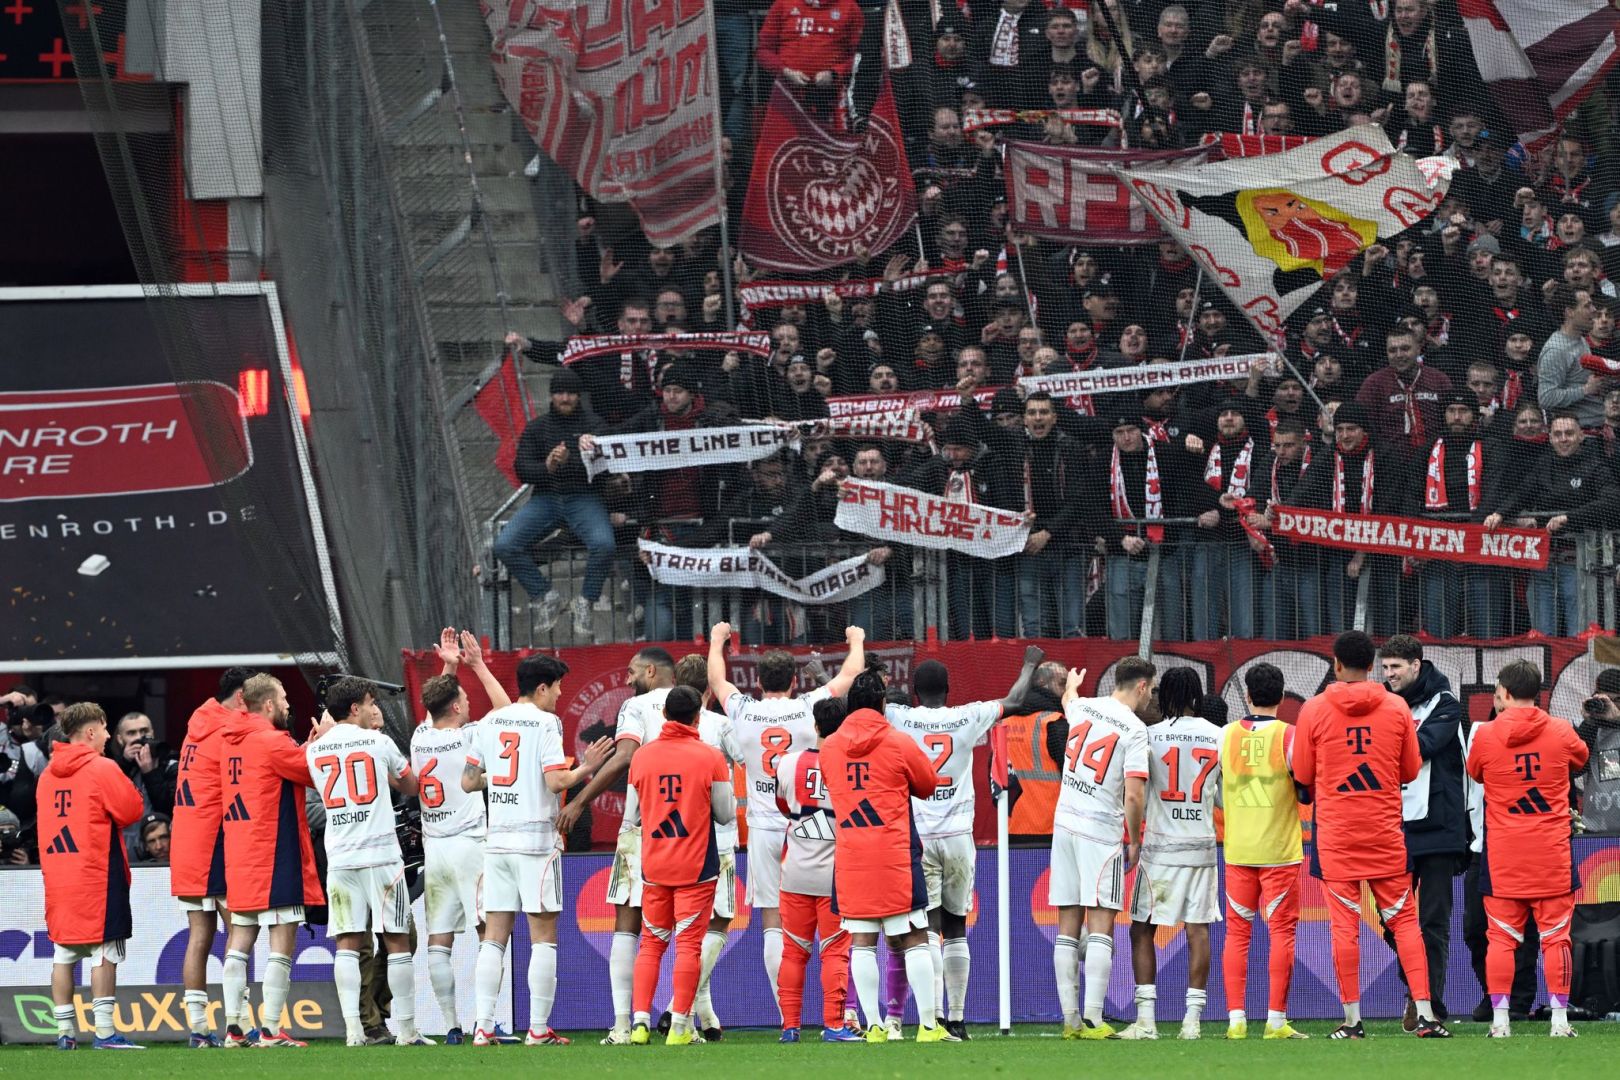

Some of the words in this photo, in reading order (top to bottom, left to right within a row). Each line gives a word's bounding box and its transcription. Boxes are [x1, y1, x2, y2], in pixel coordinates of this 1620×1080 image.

[1037, 368, 1173, 393] DURCHBOXEN
[1278, 511, 1466, 554] DURCHHALTEN
[1479, 532, 1542, 561] NICK
[492, 731, 521, 787] 3
[760, 726, 792, 778] 8
[923, 734, 954, 787] 2
[1065, 719, 1121, 786] 44
[1165, 733, 1192, 742] BAYERN
[314, 751, 379, 810] 20
[418, 755, 446, 809] 6
[489, 792, 520, 805] INJAE
[1160, 746, 1219, 804] 17
[332, 810, 371, 826] BISCHOF
[1171, 807, 1203, 821] OLISE
[73, 991, 323, 1033] buXtrde
